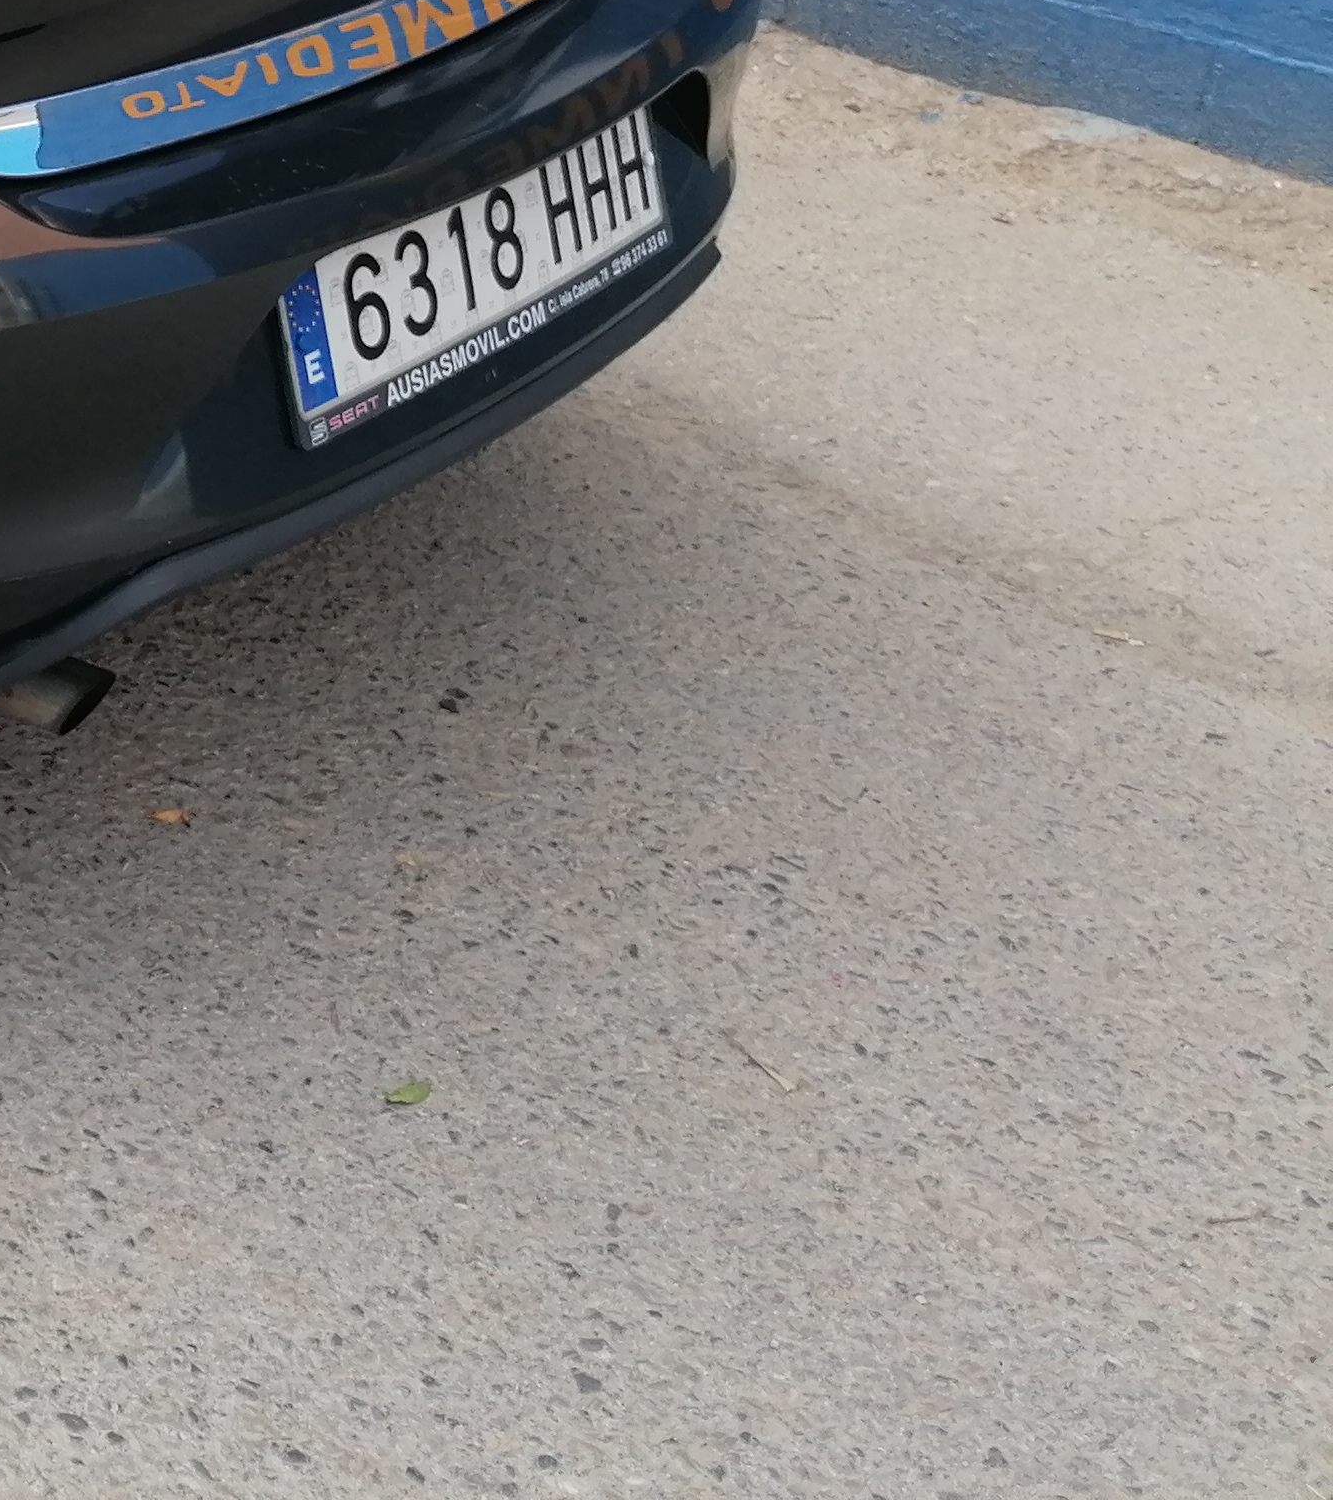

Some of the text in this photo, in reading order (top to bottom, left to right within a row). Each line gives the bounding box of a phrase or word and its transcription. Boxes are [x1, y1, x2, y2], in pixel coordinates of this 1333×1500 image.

[343, 109, 651, 361] 6318 HHH
[303, 349, 325, 384] E
[328, 395, 380, 432] SEAT
[387, 301, 547, 407] AUSIASMOVIL.COM
